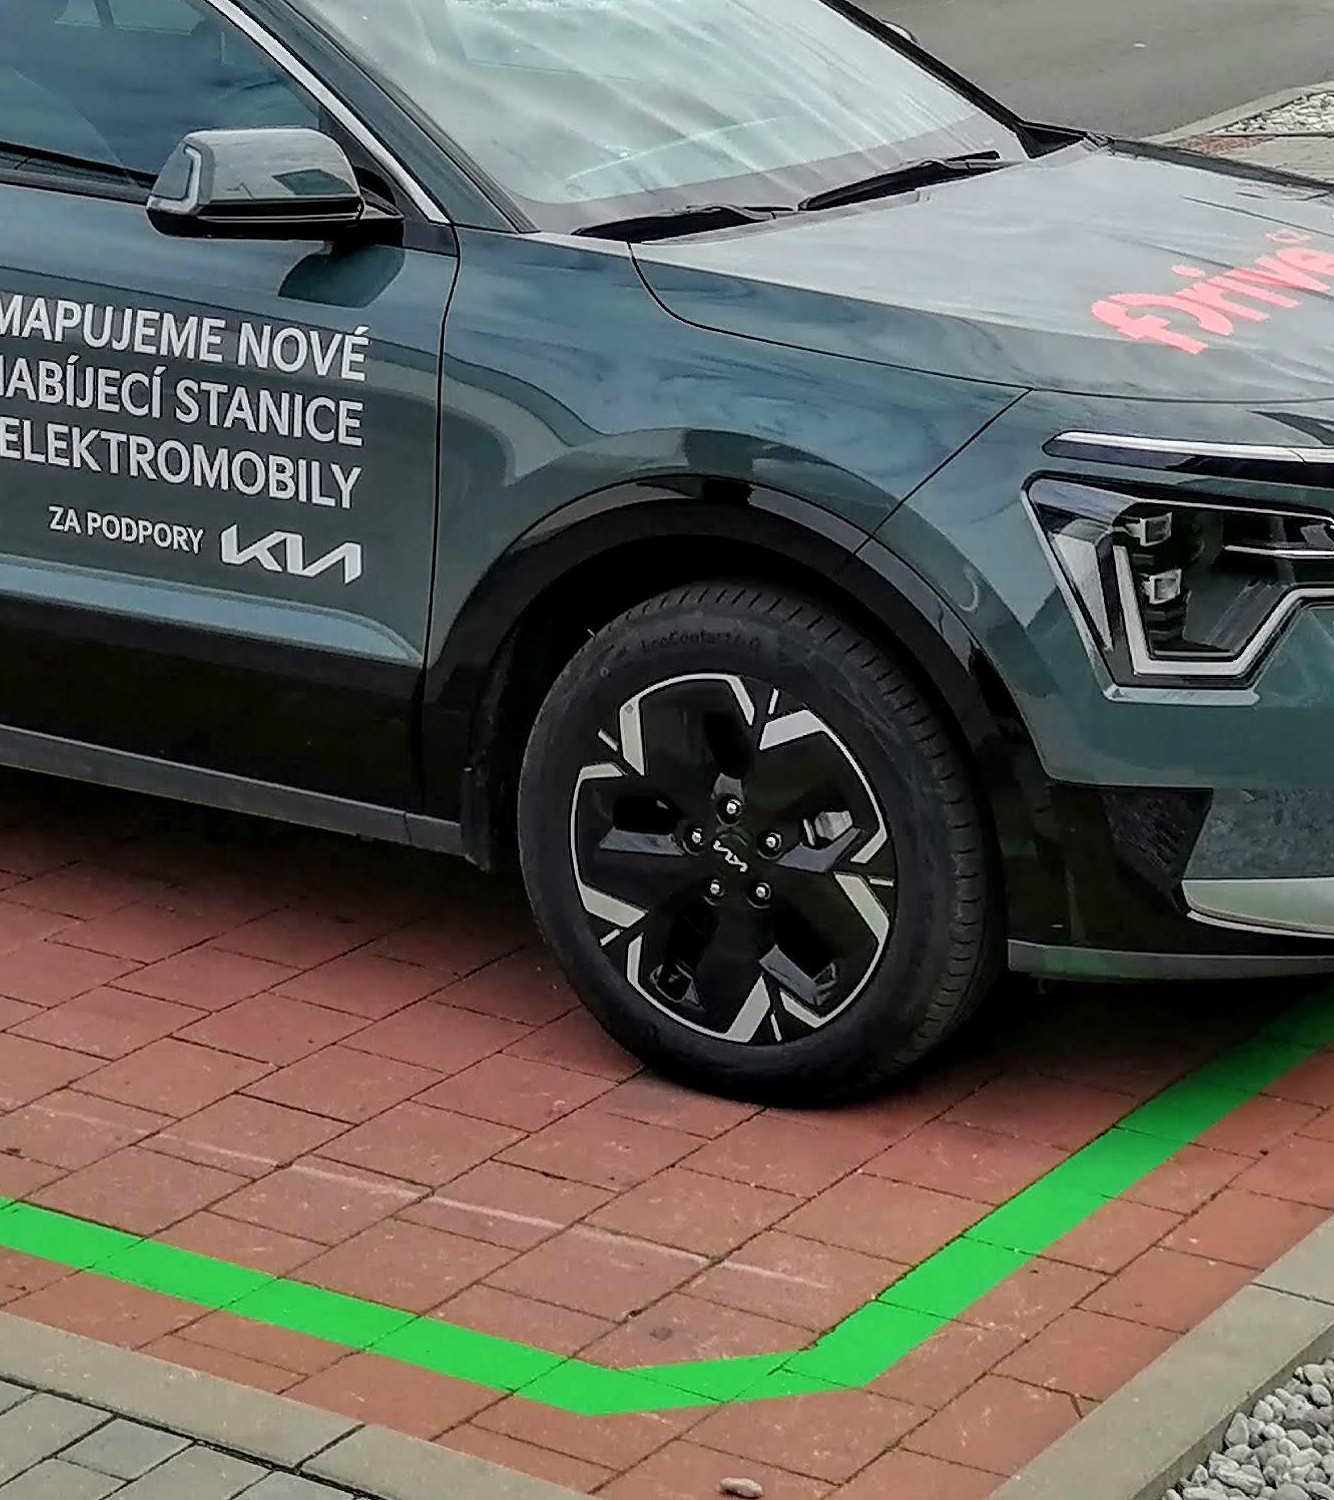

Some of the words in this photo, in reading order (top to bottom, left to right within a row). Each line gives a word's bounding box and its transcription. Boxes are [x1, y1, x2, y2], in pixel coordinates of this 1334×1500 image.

[236, 322, 372, 382] NOVÉ
[175, 379, 365, 447] STANICE
[48, 506, 82, 534] ZA
[87, 511, 204, 555] PODPORY
